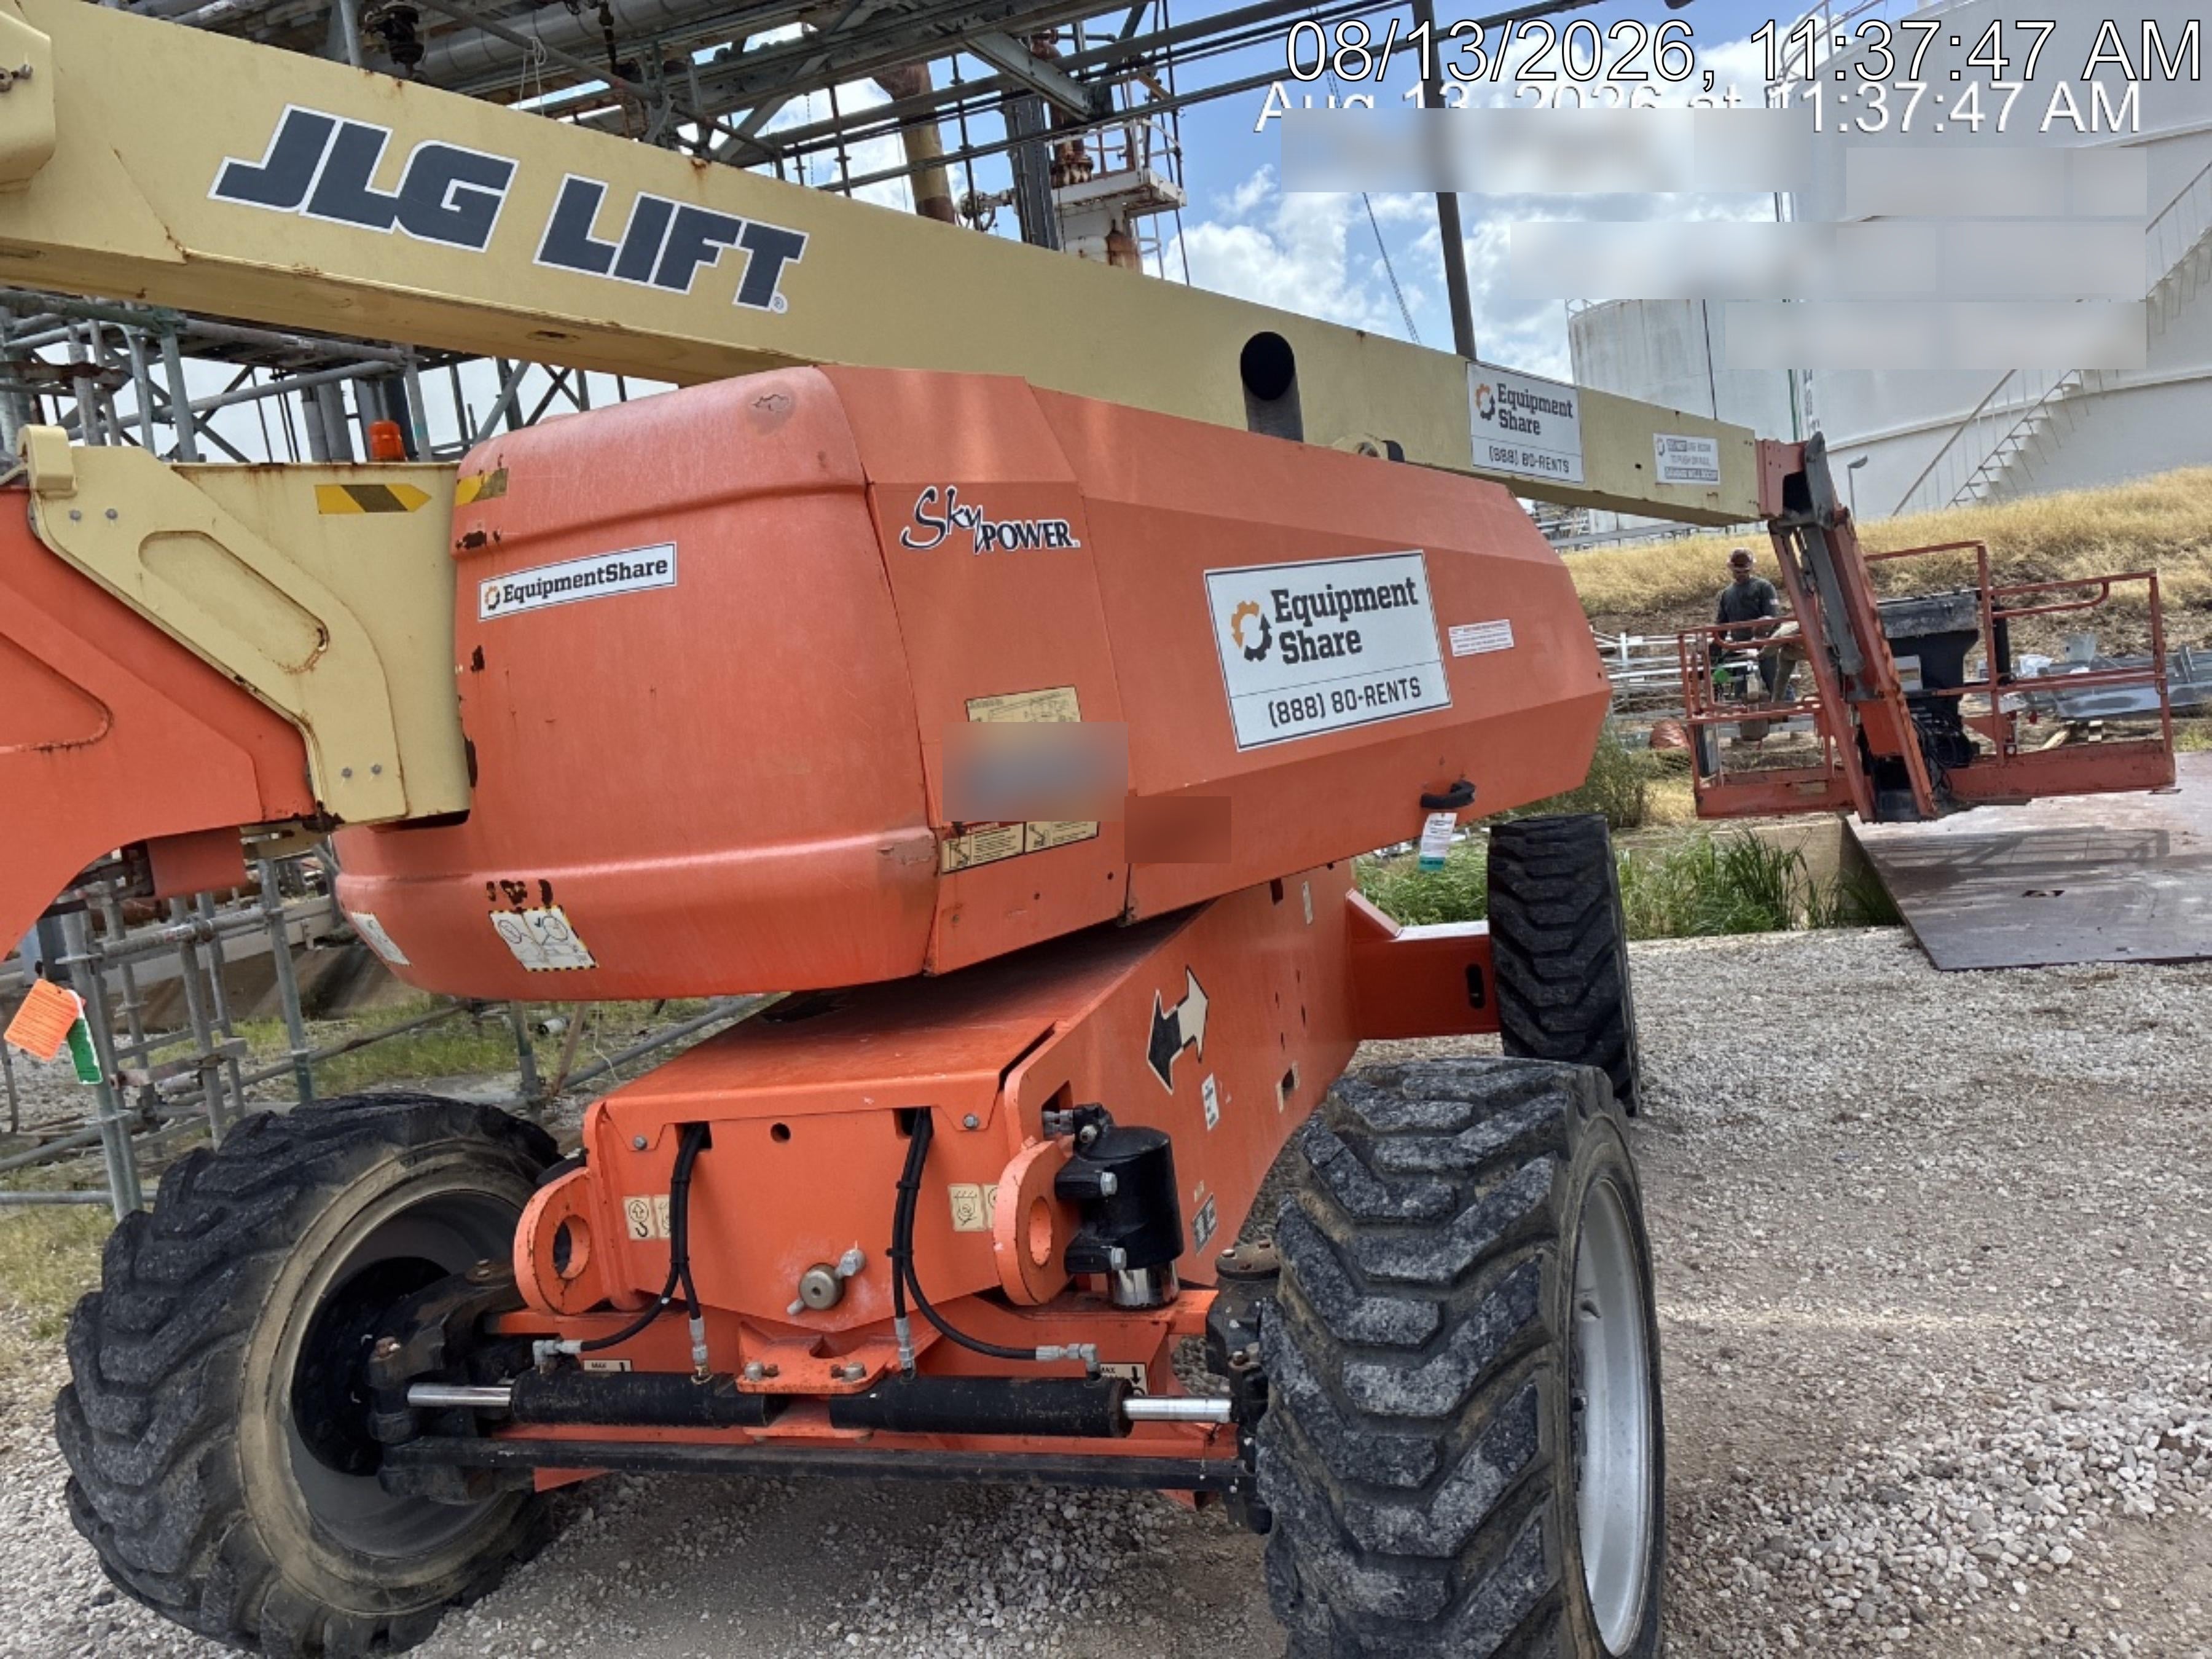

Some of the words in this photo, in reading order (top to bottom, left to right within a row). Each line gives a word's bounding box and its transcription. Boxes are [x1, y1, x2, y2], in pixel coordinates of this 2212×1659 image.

[208, 104, 519, 253] JLG
[1497, 383, 1573, 418] Equipment
[1499, 409, 1541, 435] Share
[503, 559, 668, 603] EquipmentShare
[1271, 577, 1418, 627] Equipment
[1279, 630, 1363, 664] Share
[1268, 692, 1325, 728] (888)
[1331, 677, 1422, 713] 80-RENTS
